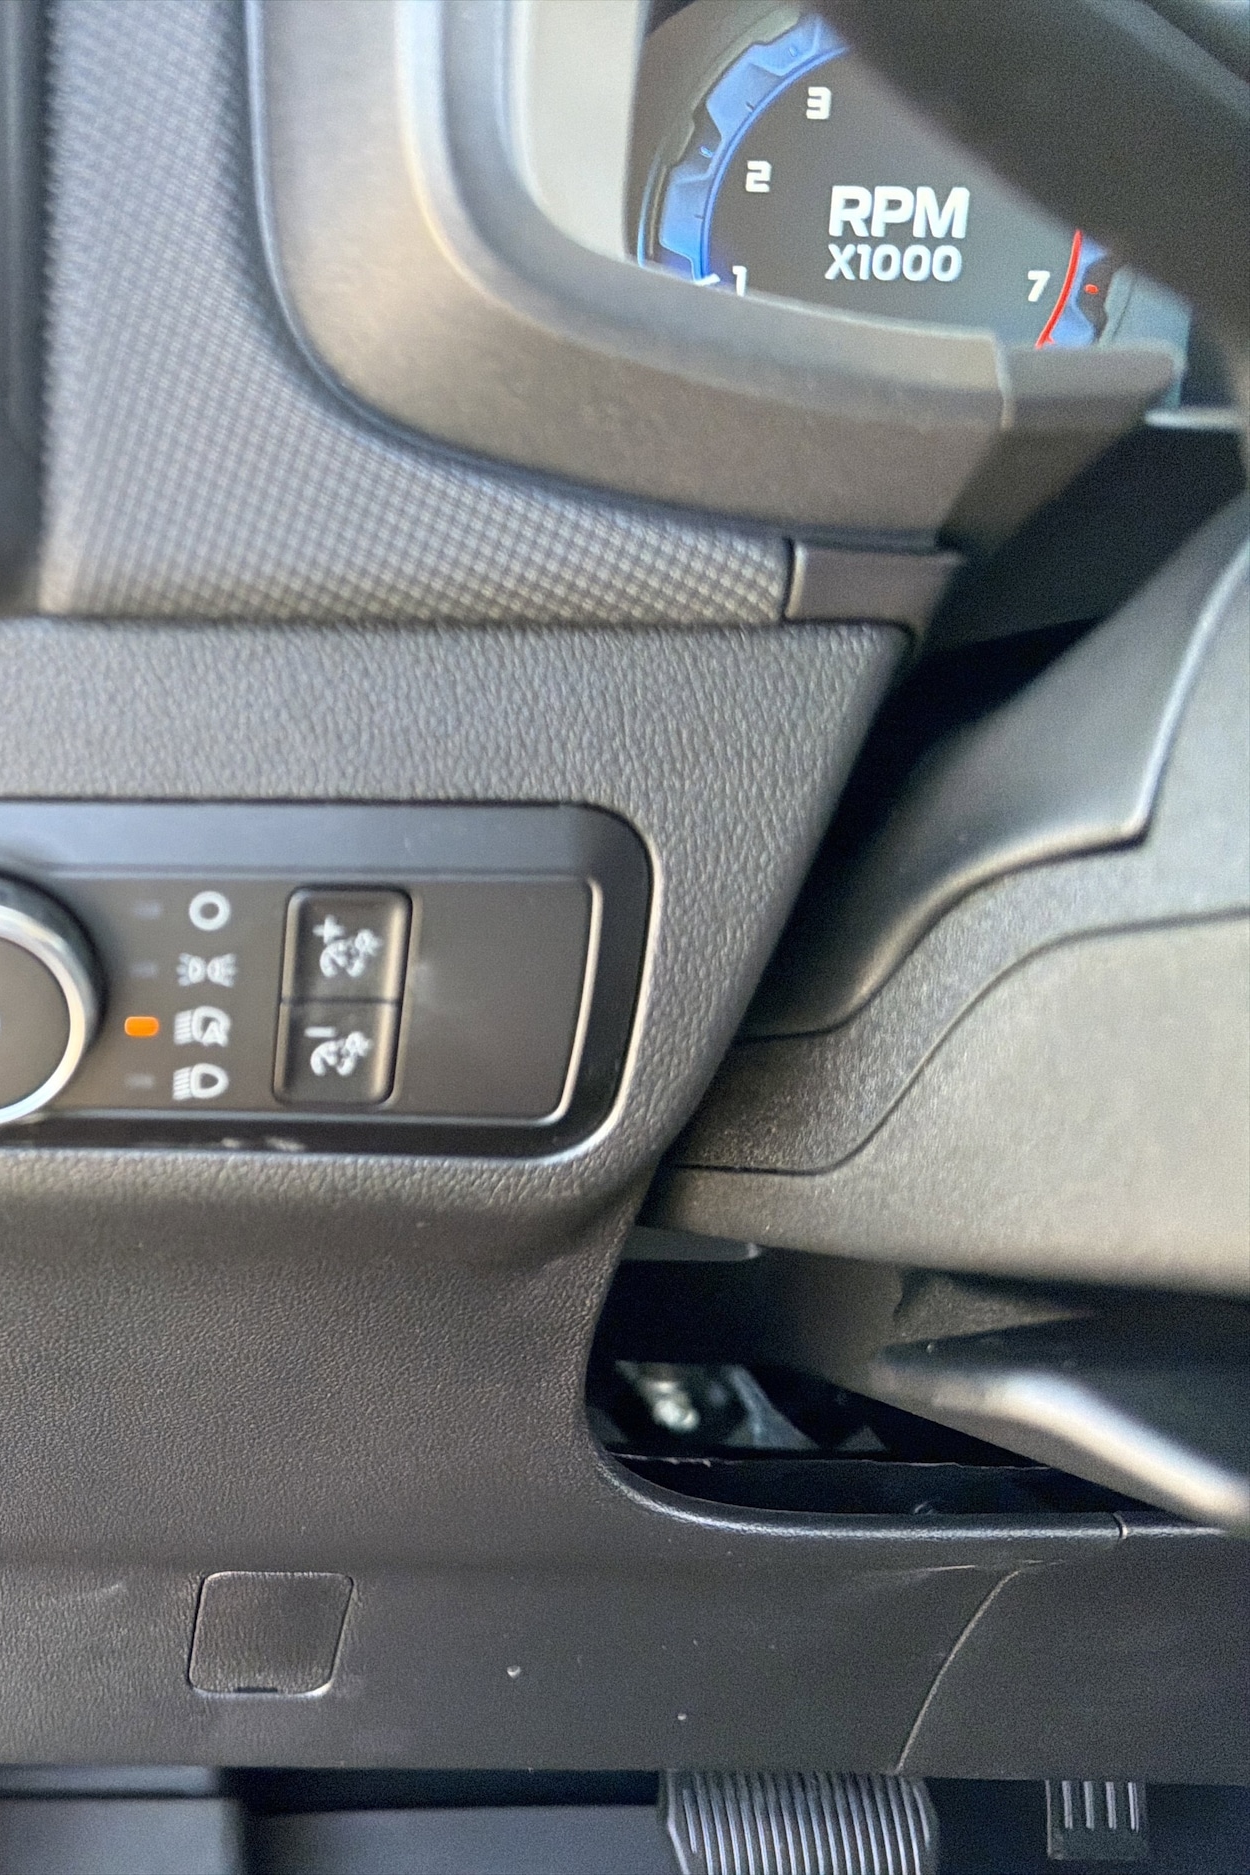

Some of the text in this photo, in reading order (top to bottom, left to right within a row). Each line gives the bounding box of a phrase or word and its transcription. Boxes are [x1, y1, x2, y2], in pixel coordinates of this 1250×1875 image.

[805, 86, 832, 120] 3
[744, 160, 772, 193] 2
[827, 184, 970, 239] RPM
[823, 243, 963, 282] X1000
[731, 265, 748, 297] 1
[1026, 269, 1051, 302] 7
